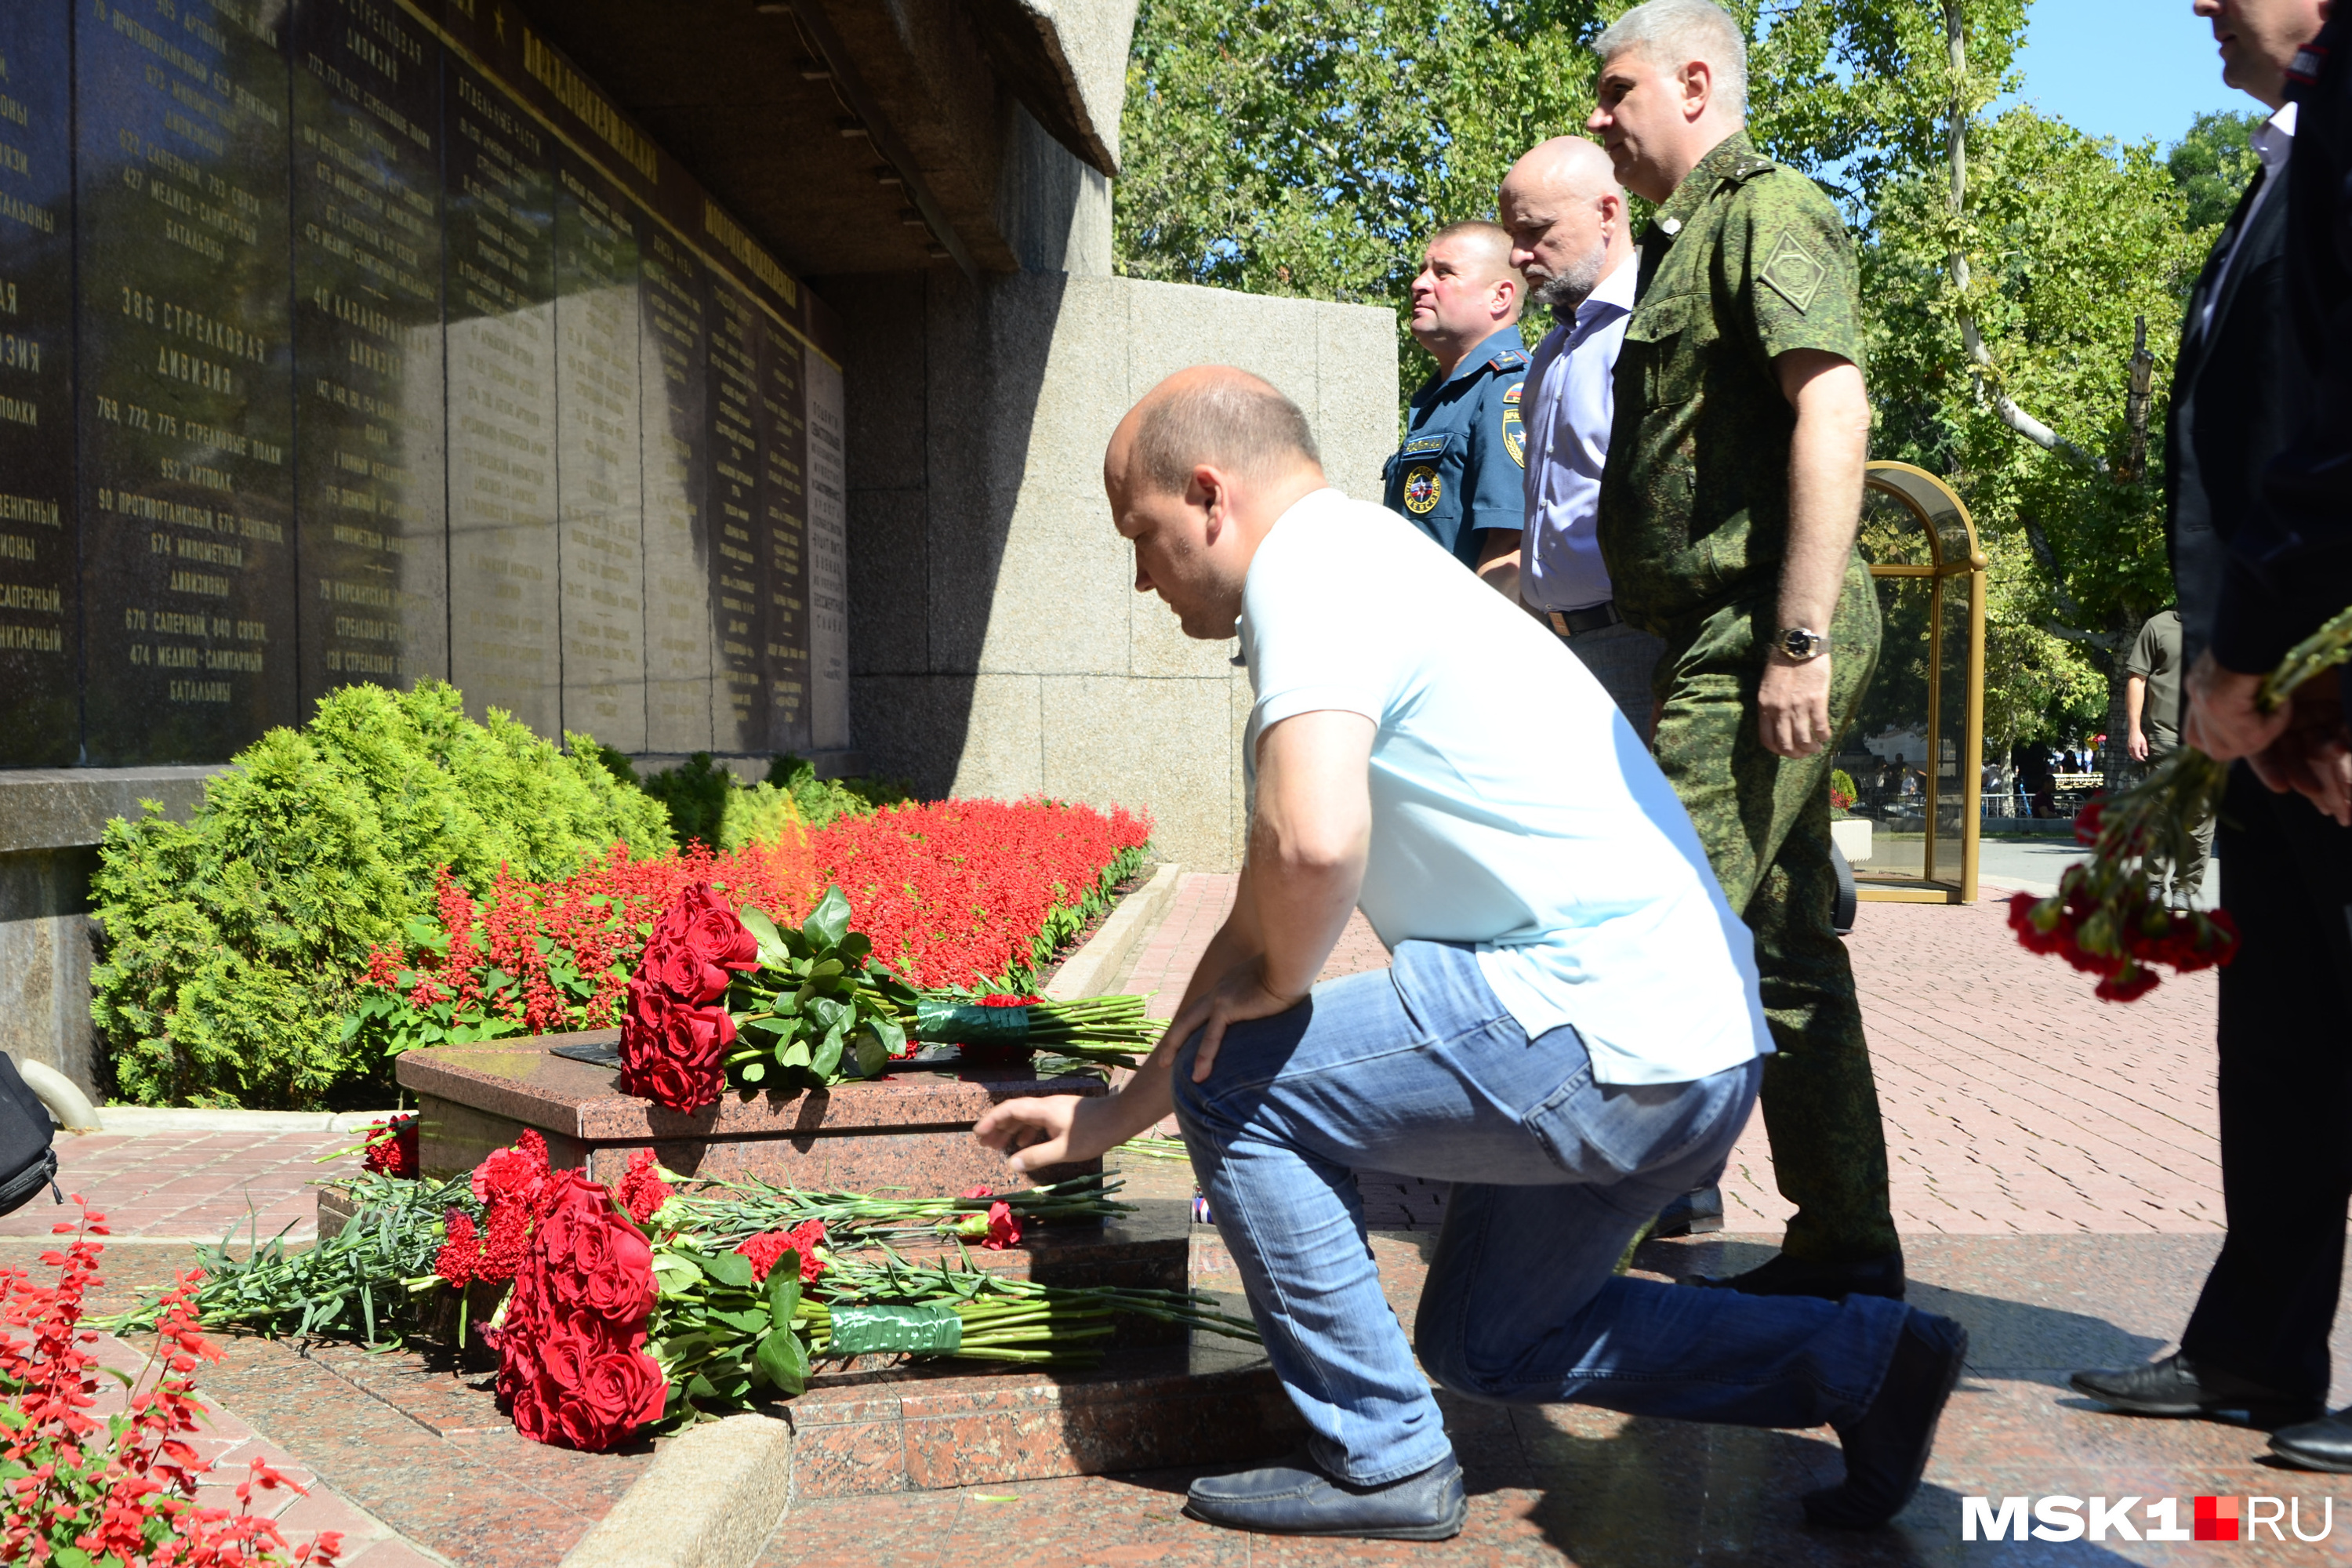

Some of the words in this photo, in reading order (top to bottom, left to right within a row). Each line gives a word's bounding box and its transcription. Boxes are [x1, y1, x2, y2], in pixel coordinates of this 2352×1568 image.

[346, 27, 398, 84] ДИВИЗИЯ
[123, 167, 143, 192] 427
[209, 173, 226, 199] 793
[165, 219, 225, 263] БАТАЛЬОНЫ
[314, 285, 329, 312] 40
[122, 286, 154, 325] 386
[164, 303, 265, 365] СТРЕЛКОВАЯ
[158, 347, 232, 394] ДИВИЗИЯ
[97, 395, 121, 426] 769,
[128, 404, 151, 433] 772,
[158, 413, 176, 437] 775
[184, 422, 247, 456] СТРЕЛКОВЫЕ
[252, 440, 282, 466] ПОЛКИ
[161, 457, 181, 482] 952
[188, 464, 234, 493] АРТПОЛК
[98, 487, 113, 511] 90
[217, 514, 235, 535] 676
[151, 532, 172, 556] 674
[177, 536, 243, 568] МИНОМЕТНЫЙ
[170, 570, 230, 598] ДИВИЗИОНЫ
[320, 577, 331, 601] 79
[125, 608, 147, 632] 670
[129, 644, 151, 667] 474
[169, 680, 232, 704] БАТАЛЬОНЫ
